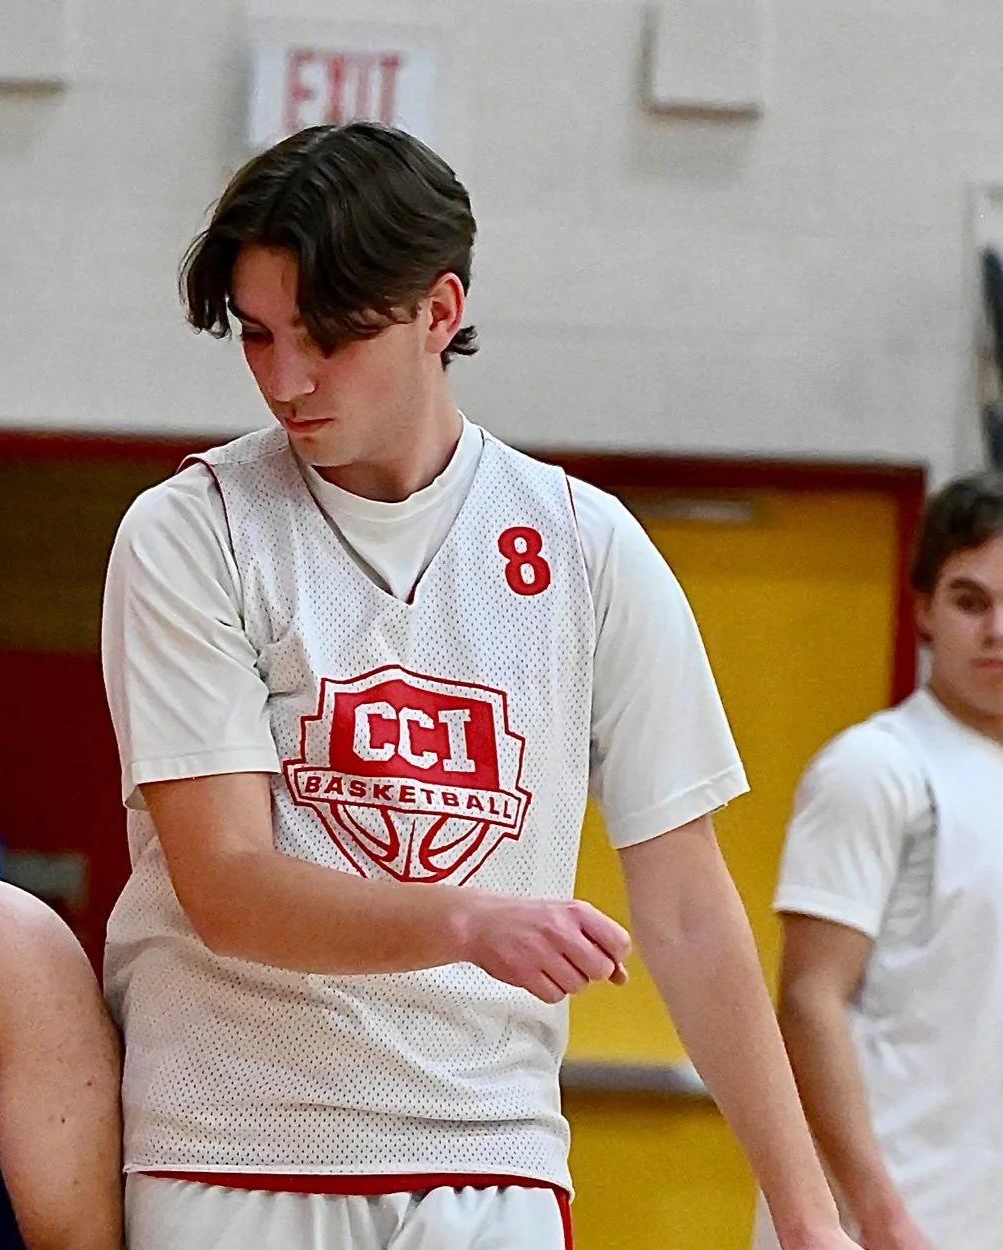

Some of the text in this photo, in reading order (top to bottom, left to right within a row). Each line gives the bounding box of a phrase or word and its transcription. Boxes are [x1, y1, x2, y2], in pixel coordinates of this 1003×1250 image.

[284, 49, 403, 129] EXIT
[497, 526, 551, 596] 8
[353, 701, 476, 773] CCI
[304, 775, 513, 820] BASKETBALL
